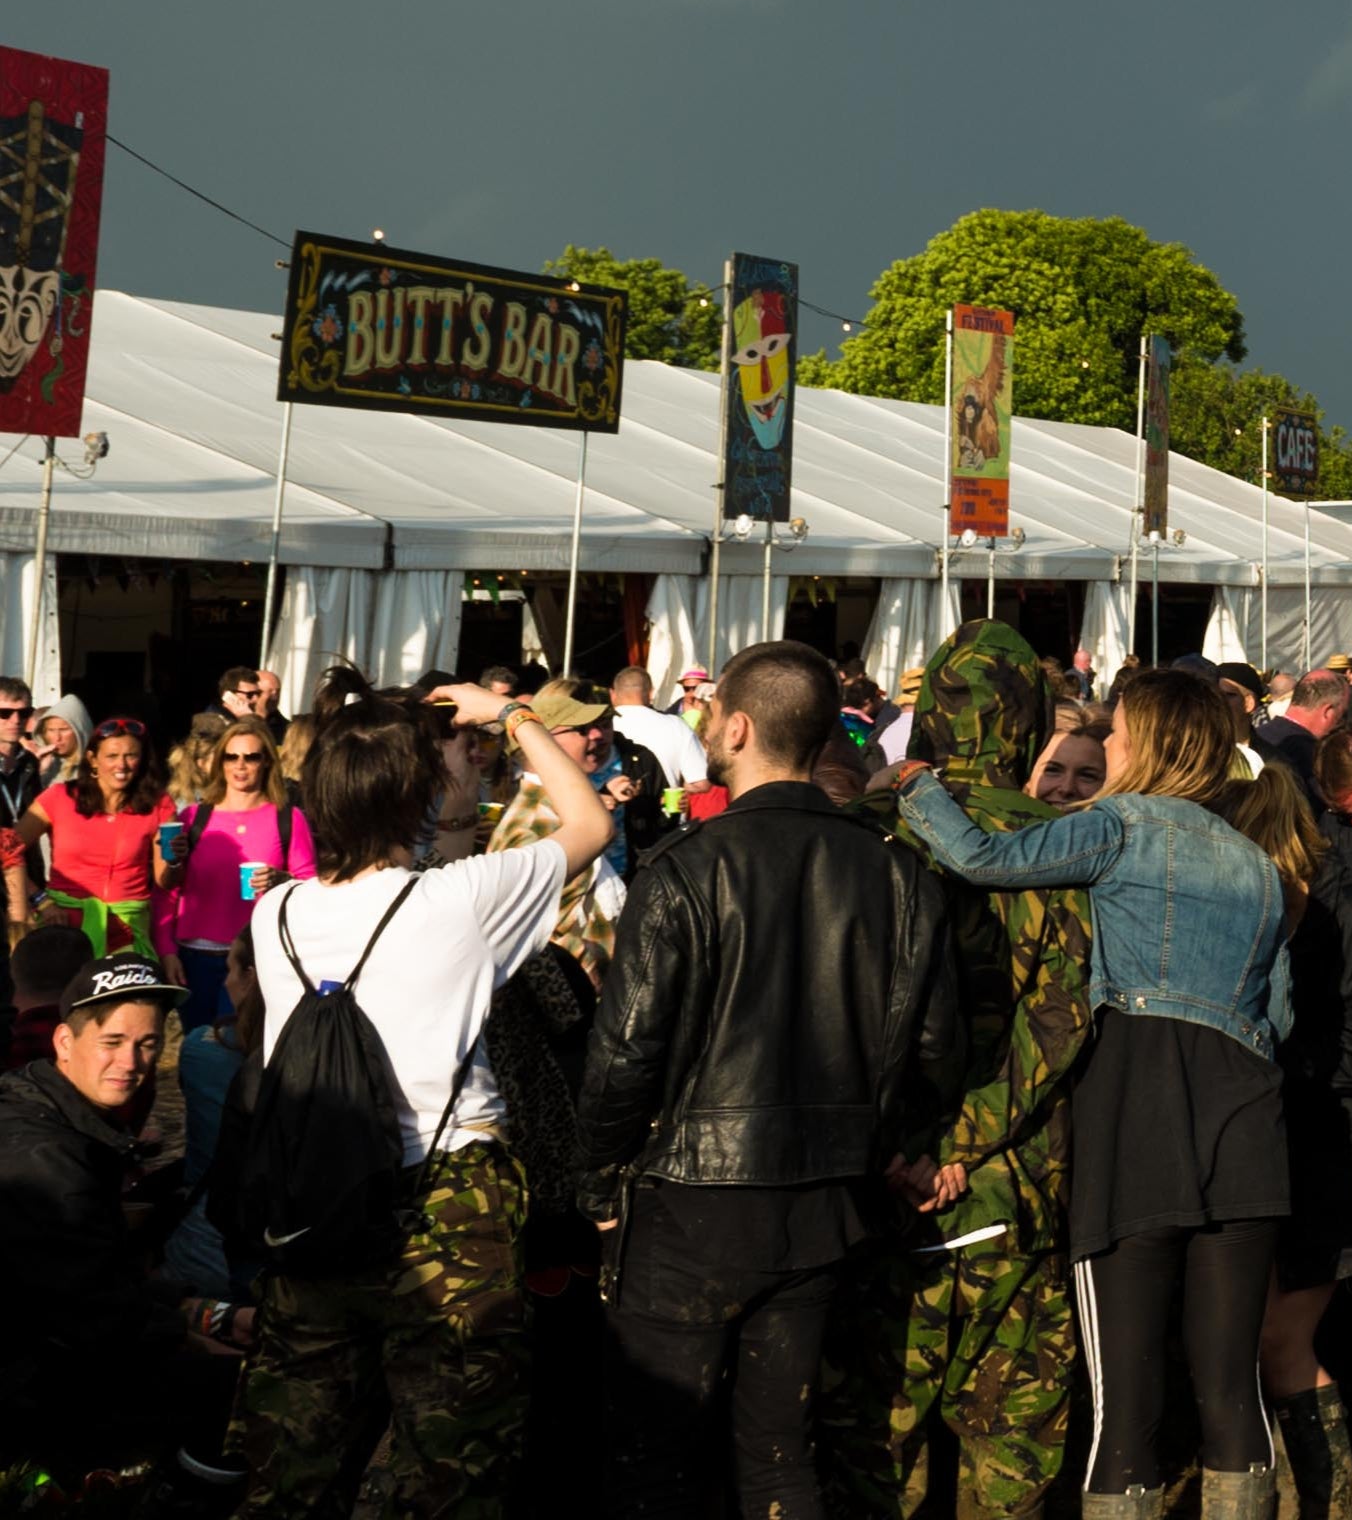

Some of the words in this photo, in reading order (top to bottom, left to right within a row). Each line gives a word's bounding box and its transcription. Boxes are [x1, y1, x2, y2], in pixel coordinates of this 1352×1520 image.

[343, 281, 495, 377] BUTT'S
[497, 301, 578, 407] BAR
[1277, 423, 1314, 471] CAFE
